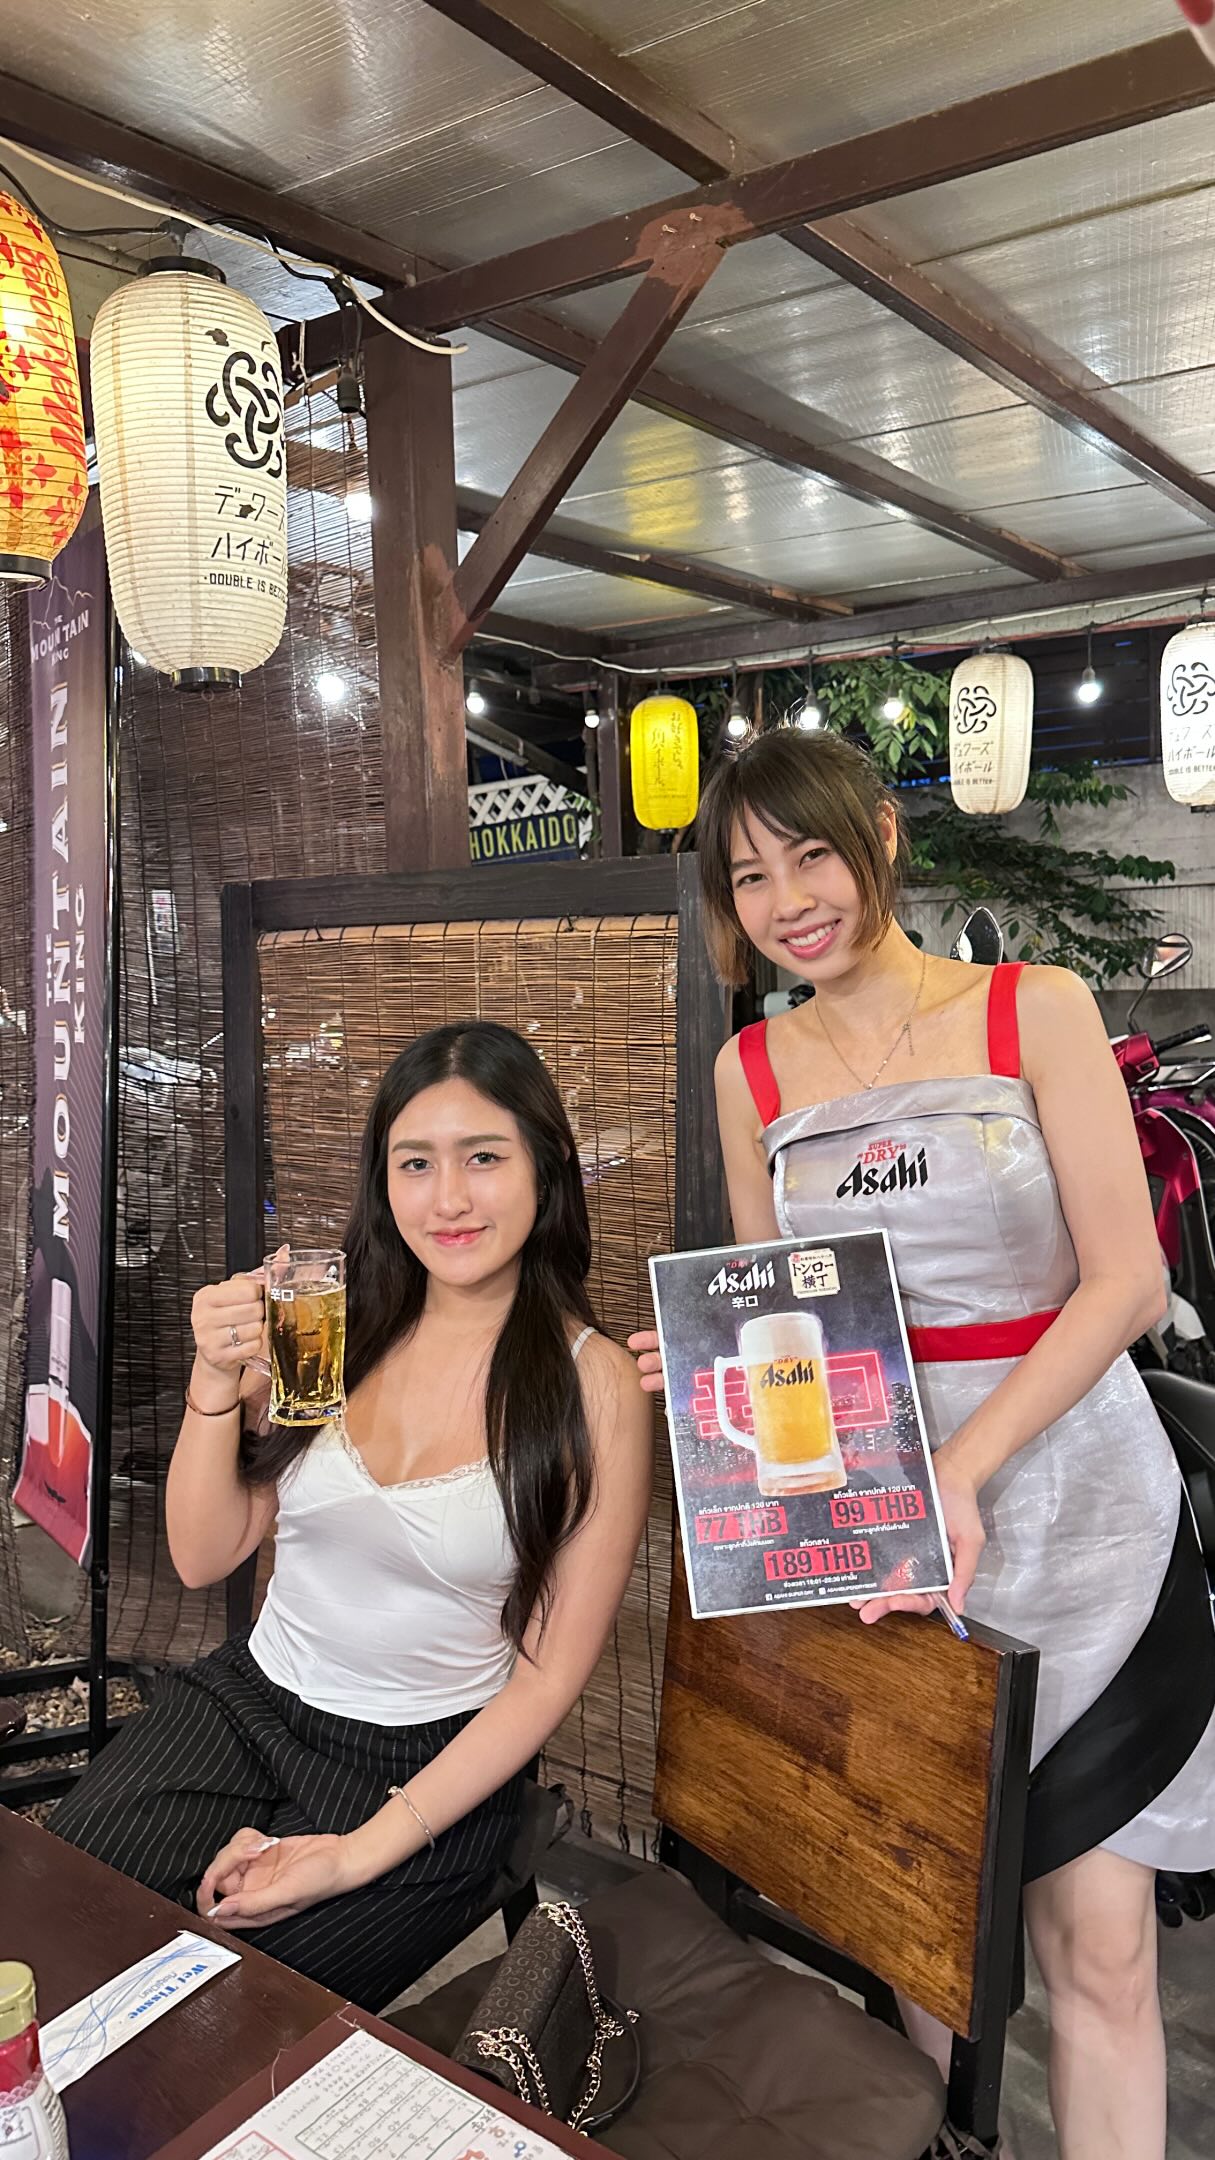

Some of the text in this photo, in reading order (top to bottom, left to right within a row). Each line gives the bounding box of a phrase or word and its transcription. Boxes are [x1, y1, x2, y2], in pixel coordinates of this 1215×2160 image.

[209, 572, 253, 590] DOUBLE
[470, 813, 577, 860] HOKKAIDO
[45, 932, 55, 1008] THE
[51, 681, 71, 1243] MOUNTAIN
[74, 883, 87, 1045] KING
[836, 1147, 929, 1198] Asahi
[707, 1261, 776, 1296] Asahi
[792, 1261, 834, 1277] トンロー
[731, 1294, 759, 1309] 辛口
[760, 1359, 814, 1389] Asahi
[699, 1509, 782, 1540] 77 THB
[835, 1493, 920, 1524] 99 THB
[768, 1543, 867, 1577] 189 THB
[177, 1964, 208, 1984] Wet
[128, 1985, 179, 2019] Tissue
